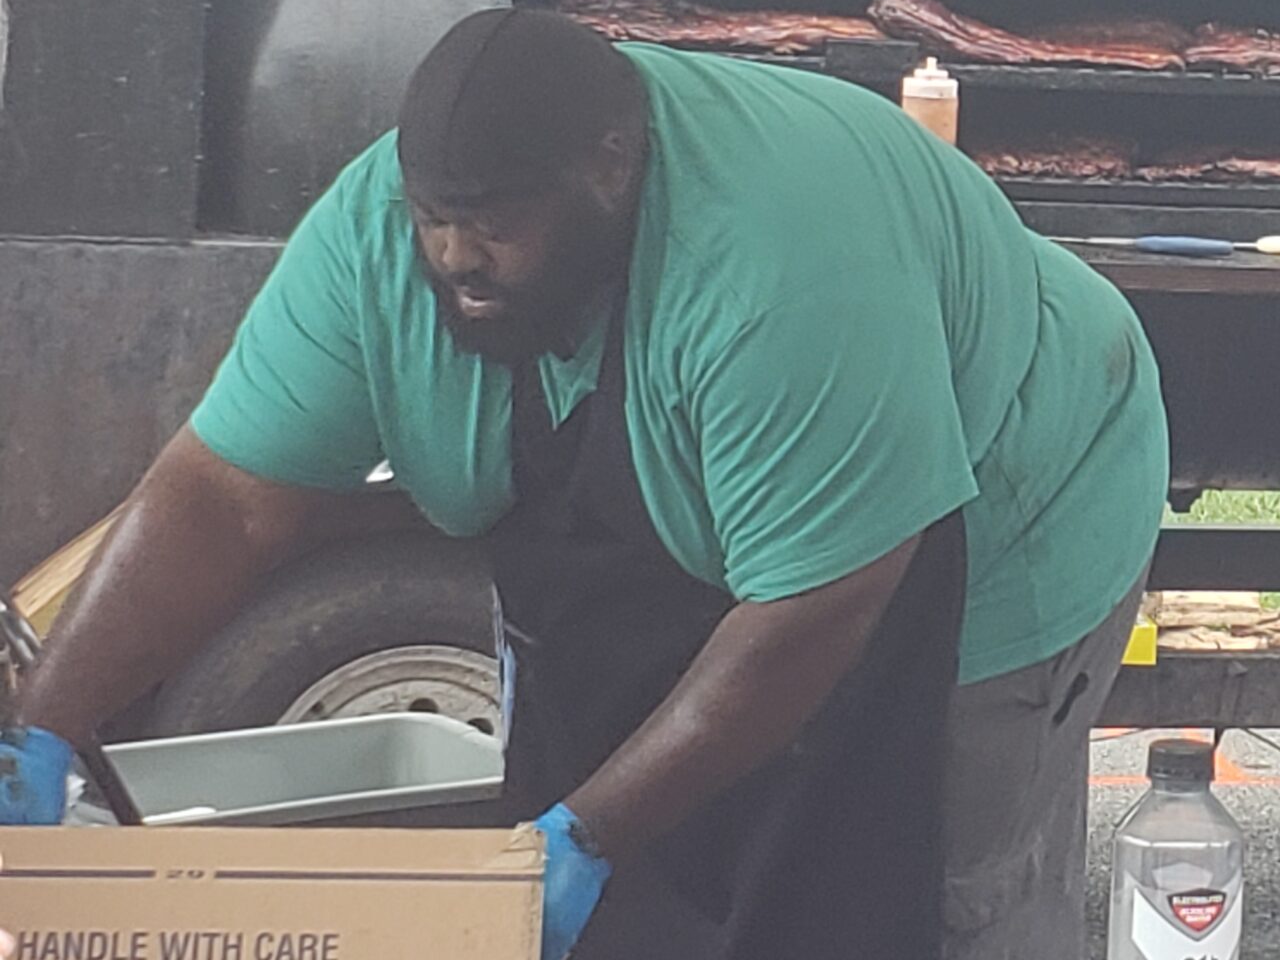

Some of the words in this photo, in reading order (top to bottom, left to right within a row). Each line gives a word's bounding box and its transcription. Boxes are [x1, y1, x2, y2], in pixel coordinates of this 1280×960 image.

[16, 930, 149, 960] HANDLE
[157, 931, 243, 960] WITH
[253, 932, 340, 960] CARE
